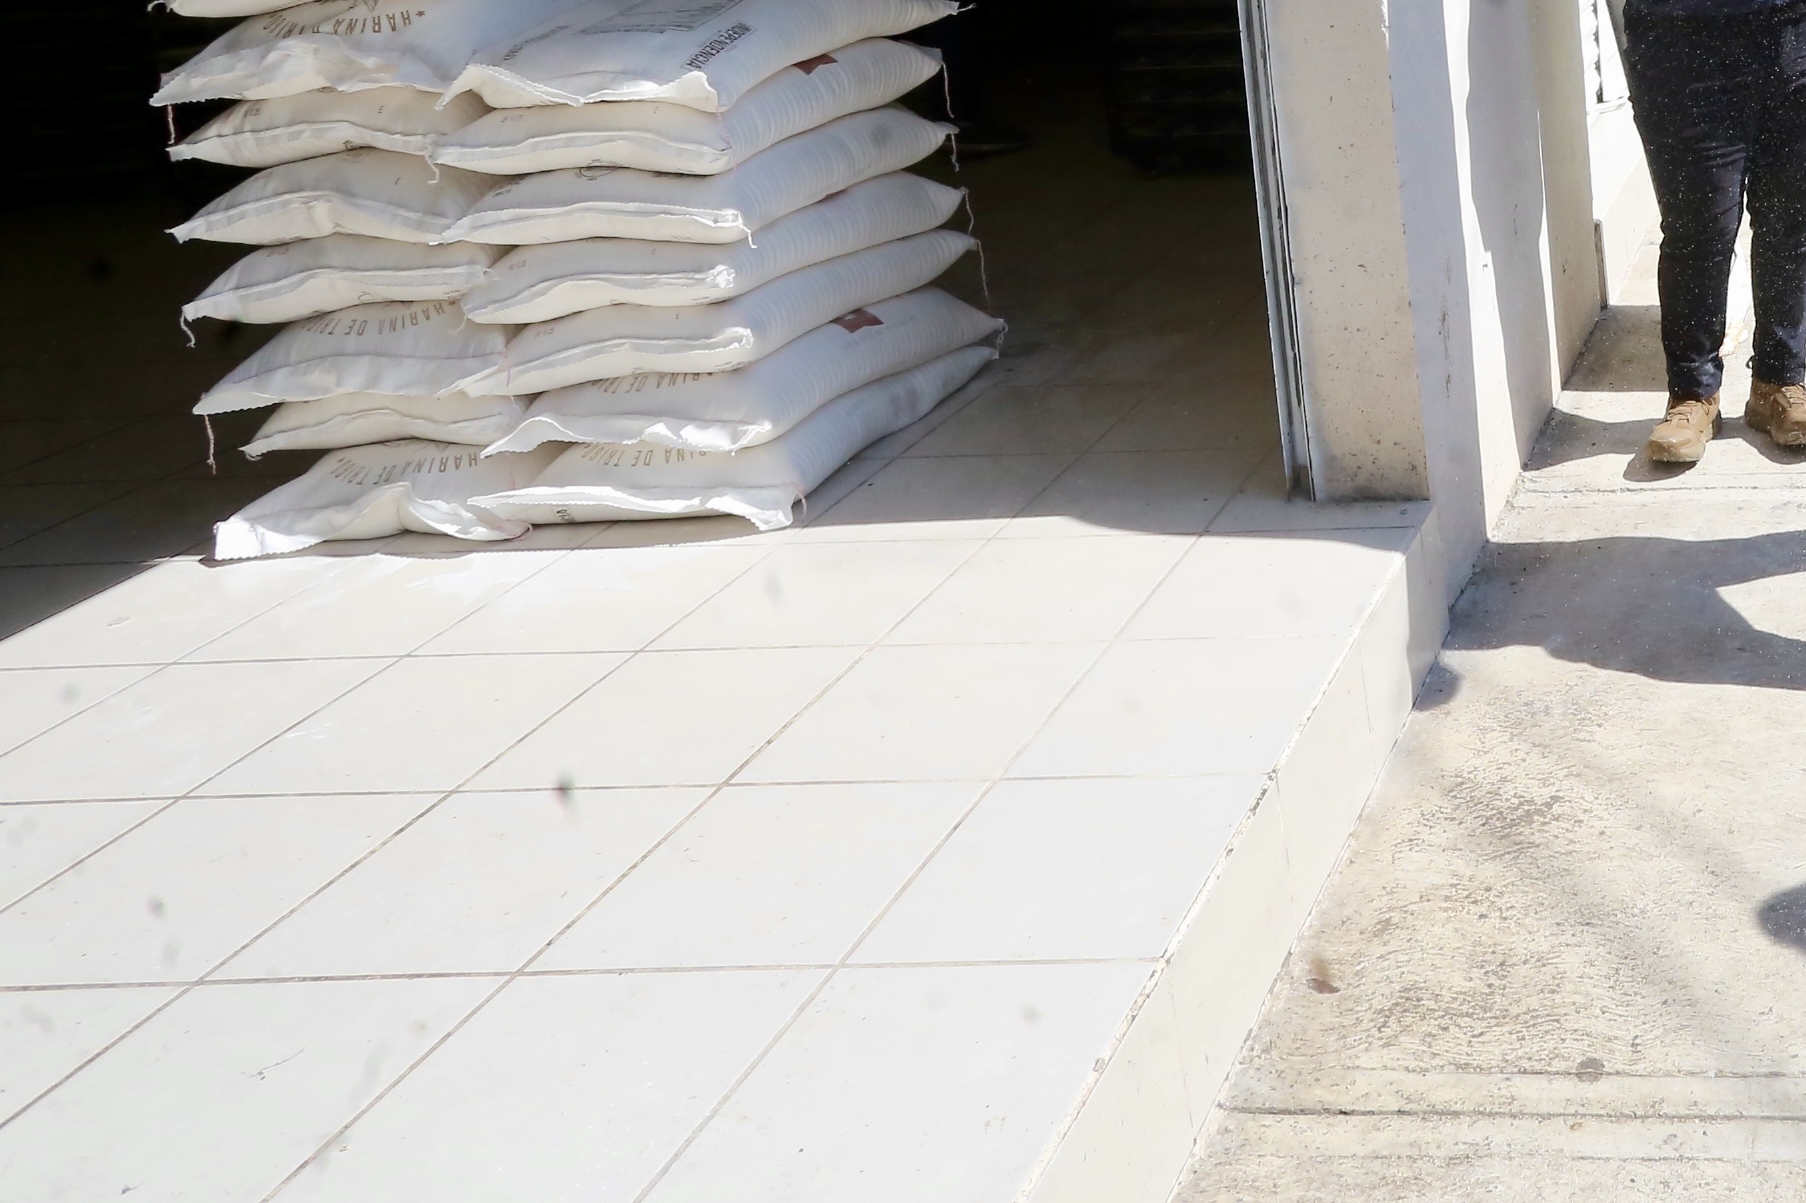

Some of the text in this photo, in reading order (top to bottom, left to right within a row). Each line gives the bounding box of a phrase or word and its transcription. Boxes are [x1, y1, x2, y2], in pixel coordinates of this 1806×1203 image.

[333, 10, 412, 35] HARINA
[686, 22, 753, 70] INDEPENDENCIA
[343, 319, 369, 336] DE
[378, 302, 446, 336] HARINA
[624, 375, 650, 394] DE
[401, 451, 479, 475] HARINA
[630, 449, 654, 468] DE
[372, 464, 398, 485] DE
